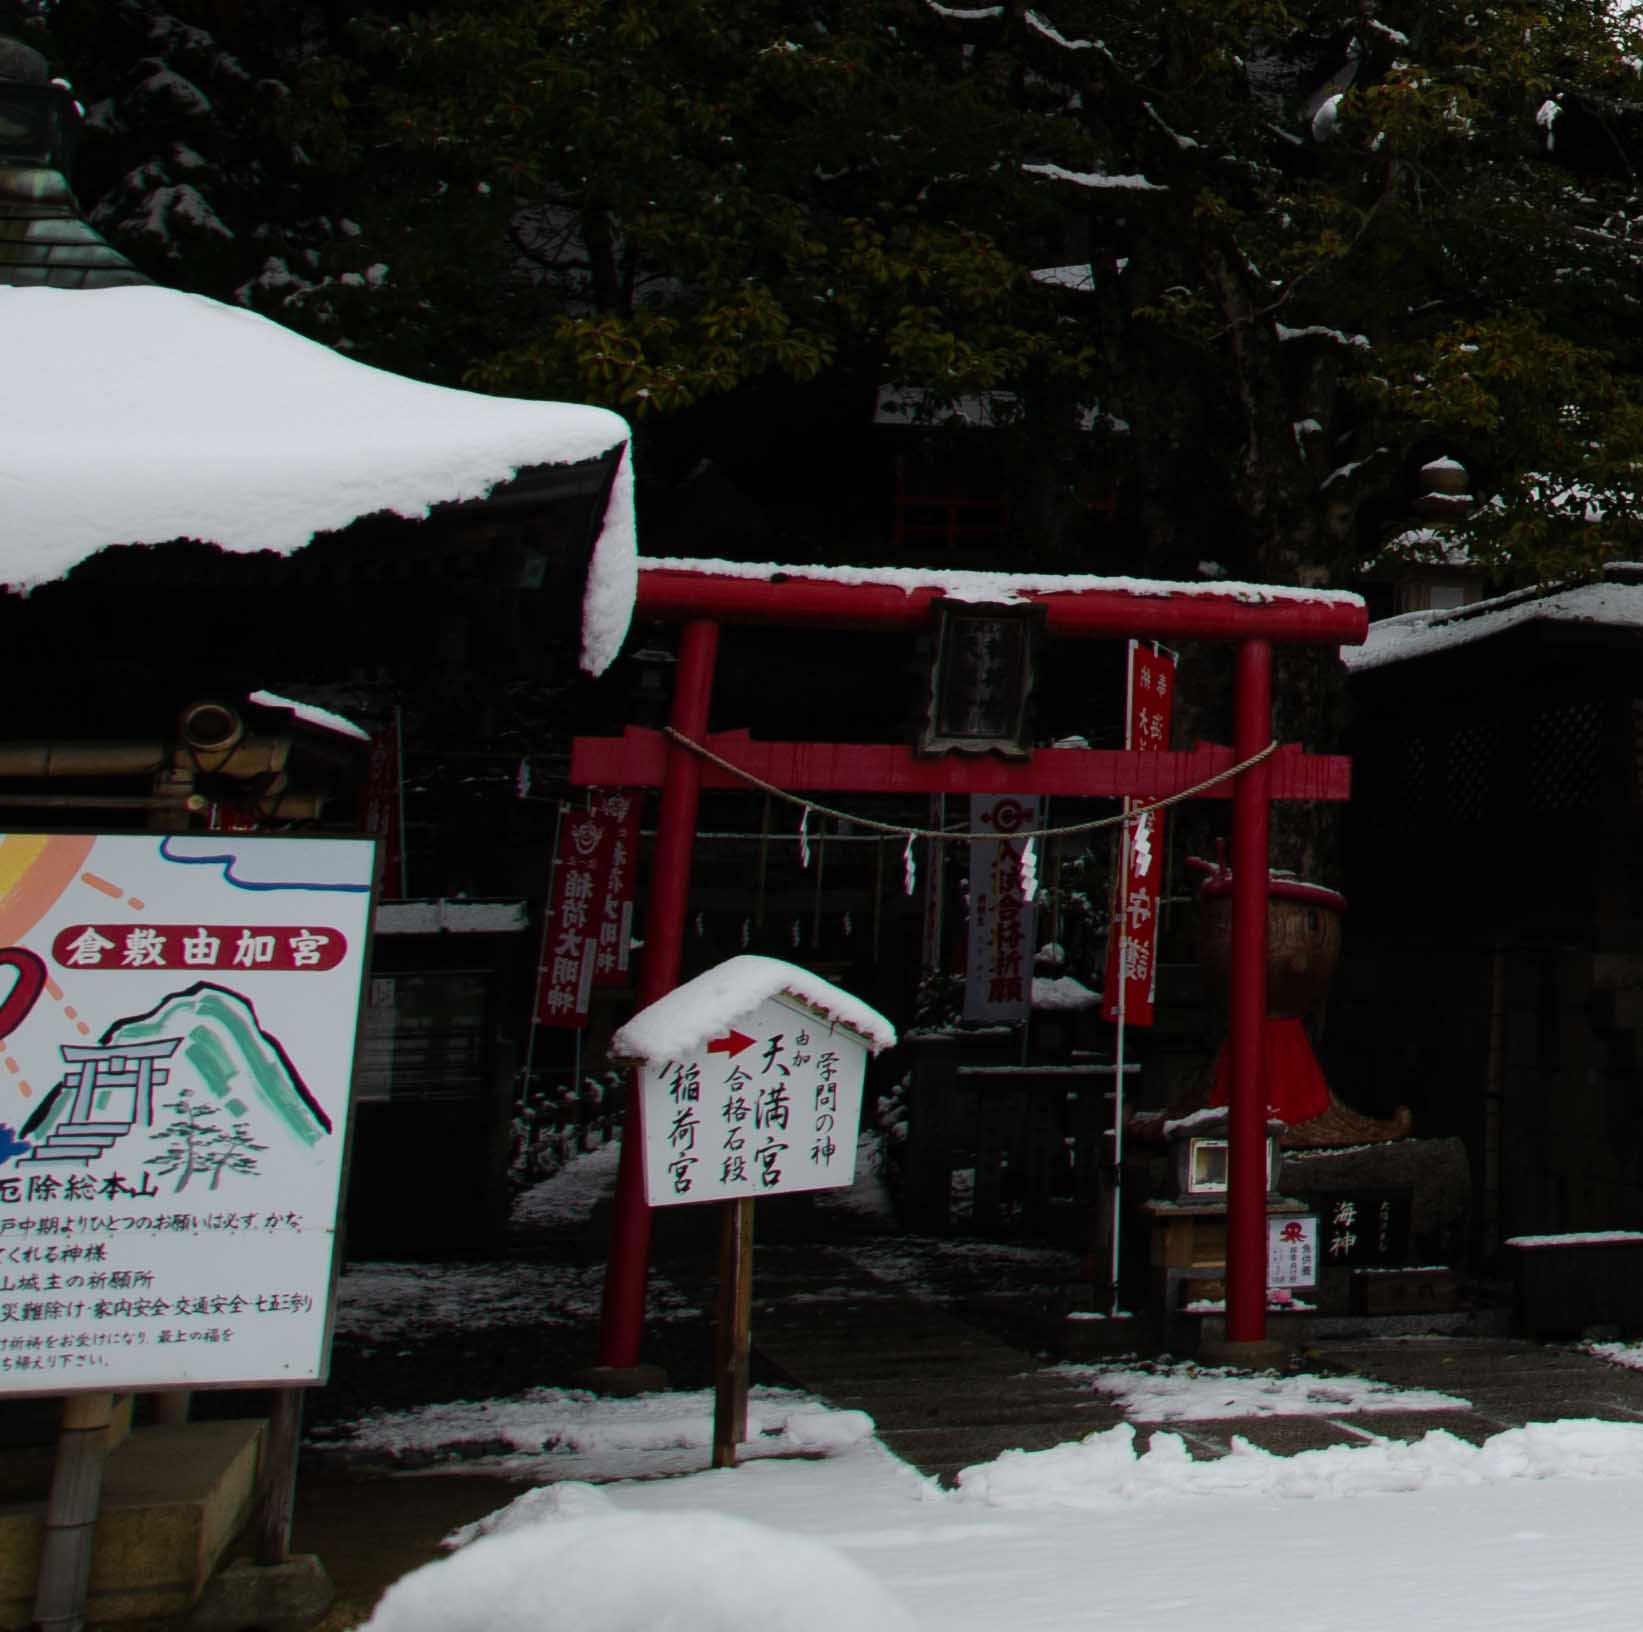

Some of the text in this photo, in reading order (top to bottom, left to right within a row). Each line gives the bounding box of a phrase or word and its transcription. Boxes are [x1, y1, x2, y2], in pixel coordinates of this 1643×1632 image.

[65, 927, 331, 967] 倉敷由加宮
[792, 1029, 811, 1067] 由加
[668, 1062, 701, 1194] 稲荷宮
[720, 1065, 753, 1185] 合格石段
[754, 1034, 790, 1188] 天満宮
[810, 1051, 840, 1168] 学問の神
[0, 1171, 159, 1203] 厄除総本山
[1329, 1200, 1359, 1257] 海神
